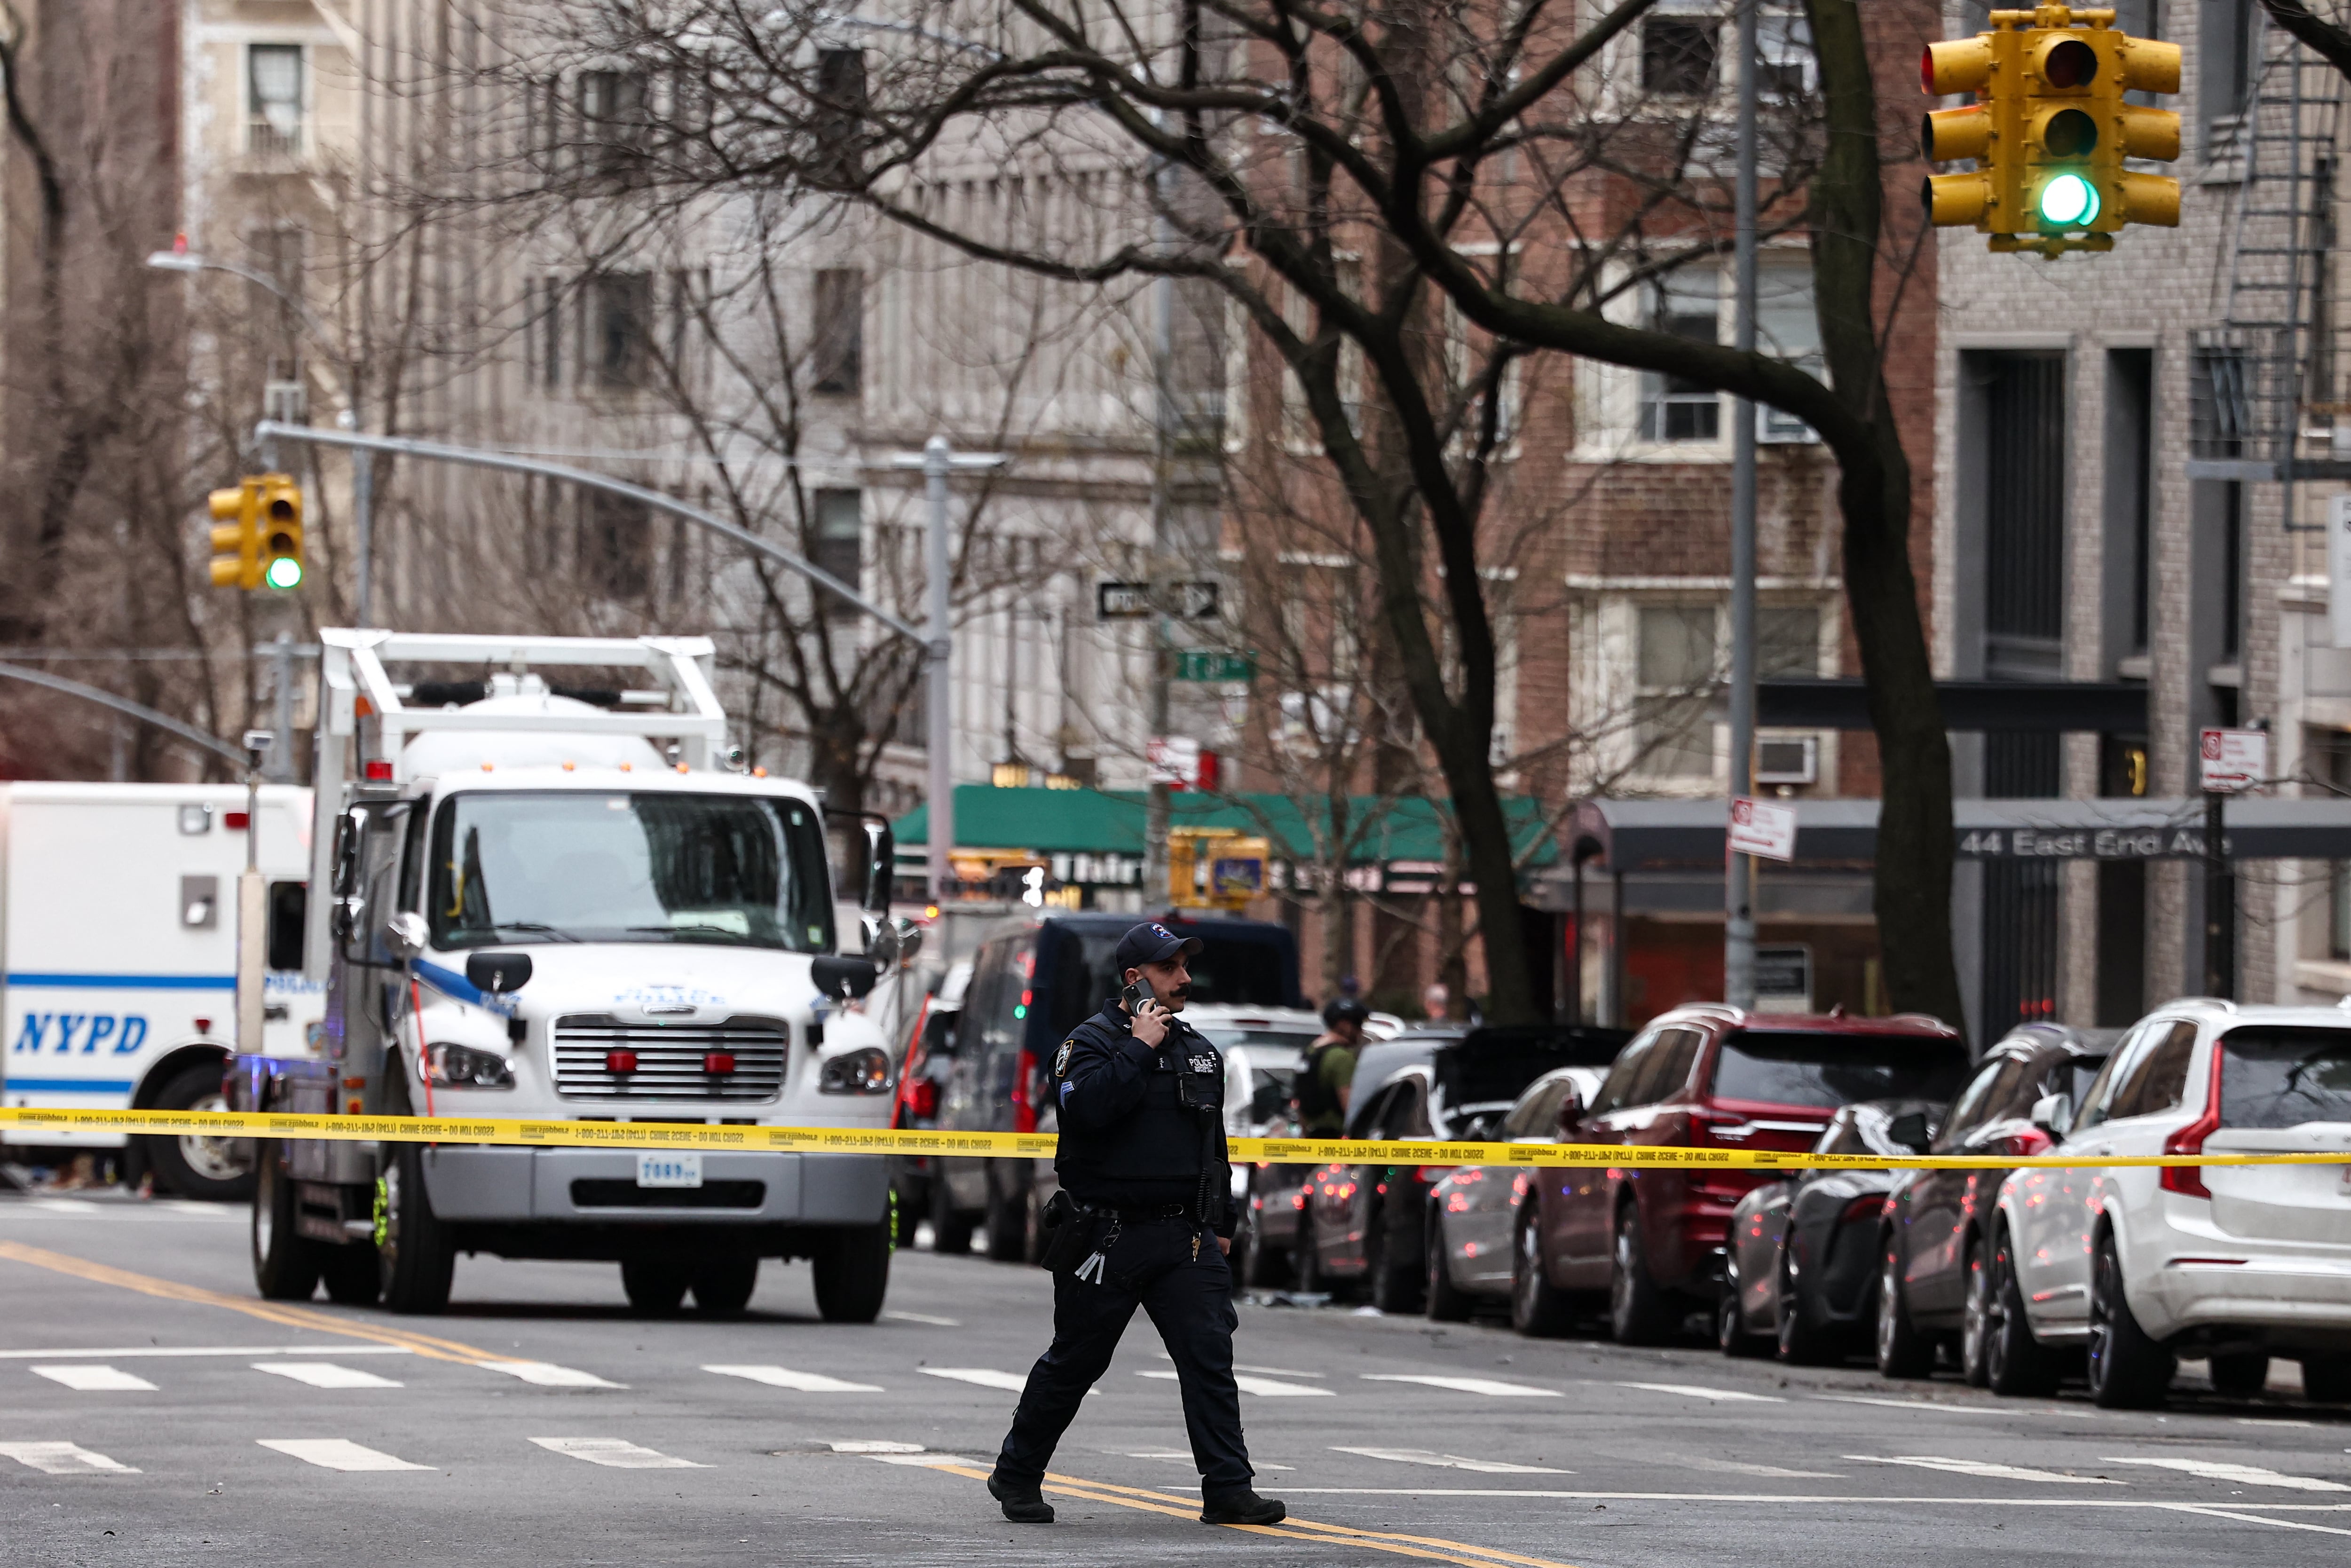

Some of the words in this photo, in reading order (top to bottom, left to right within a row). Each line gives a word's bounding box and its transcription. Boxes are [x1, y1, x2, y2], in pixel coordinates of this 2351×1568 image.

[1960, 830, 2002, 853] 44
[2012, 830, 2086, 856] East
[2094, 830, 2162, 855] End
[14, 1013, 148, 1054] NYPD
[1188, 1058, 1213, 1067] POLICE
